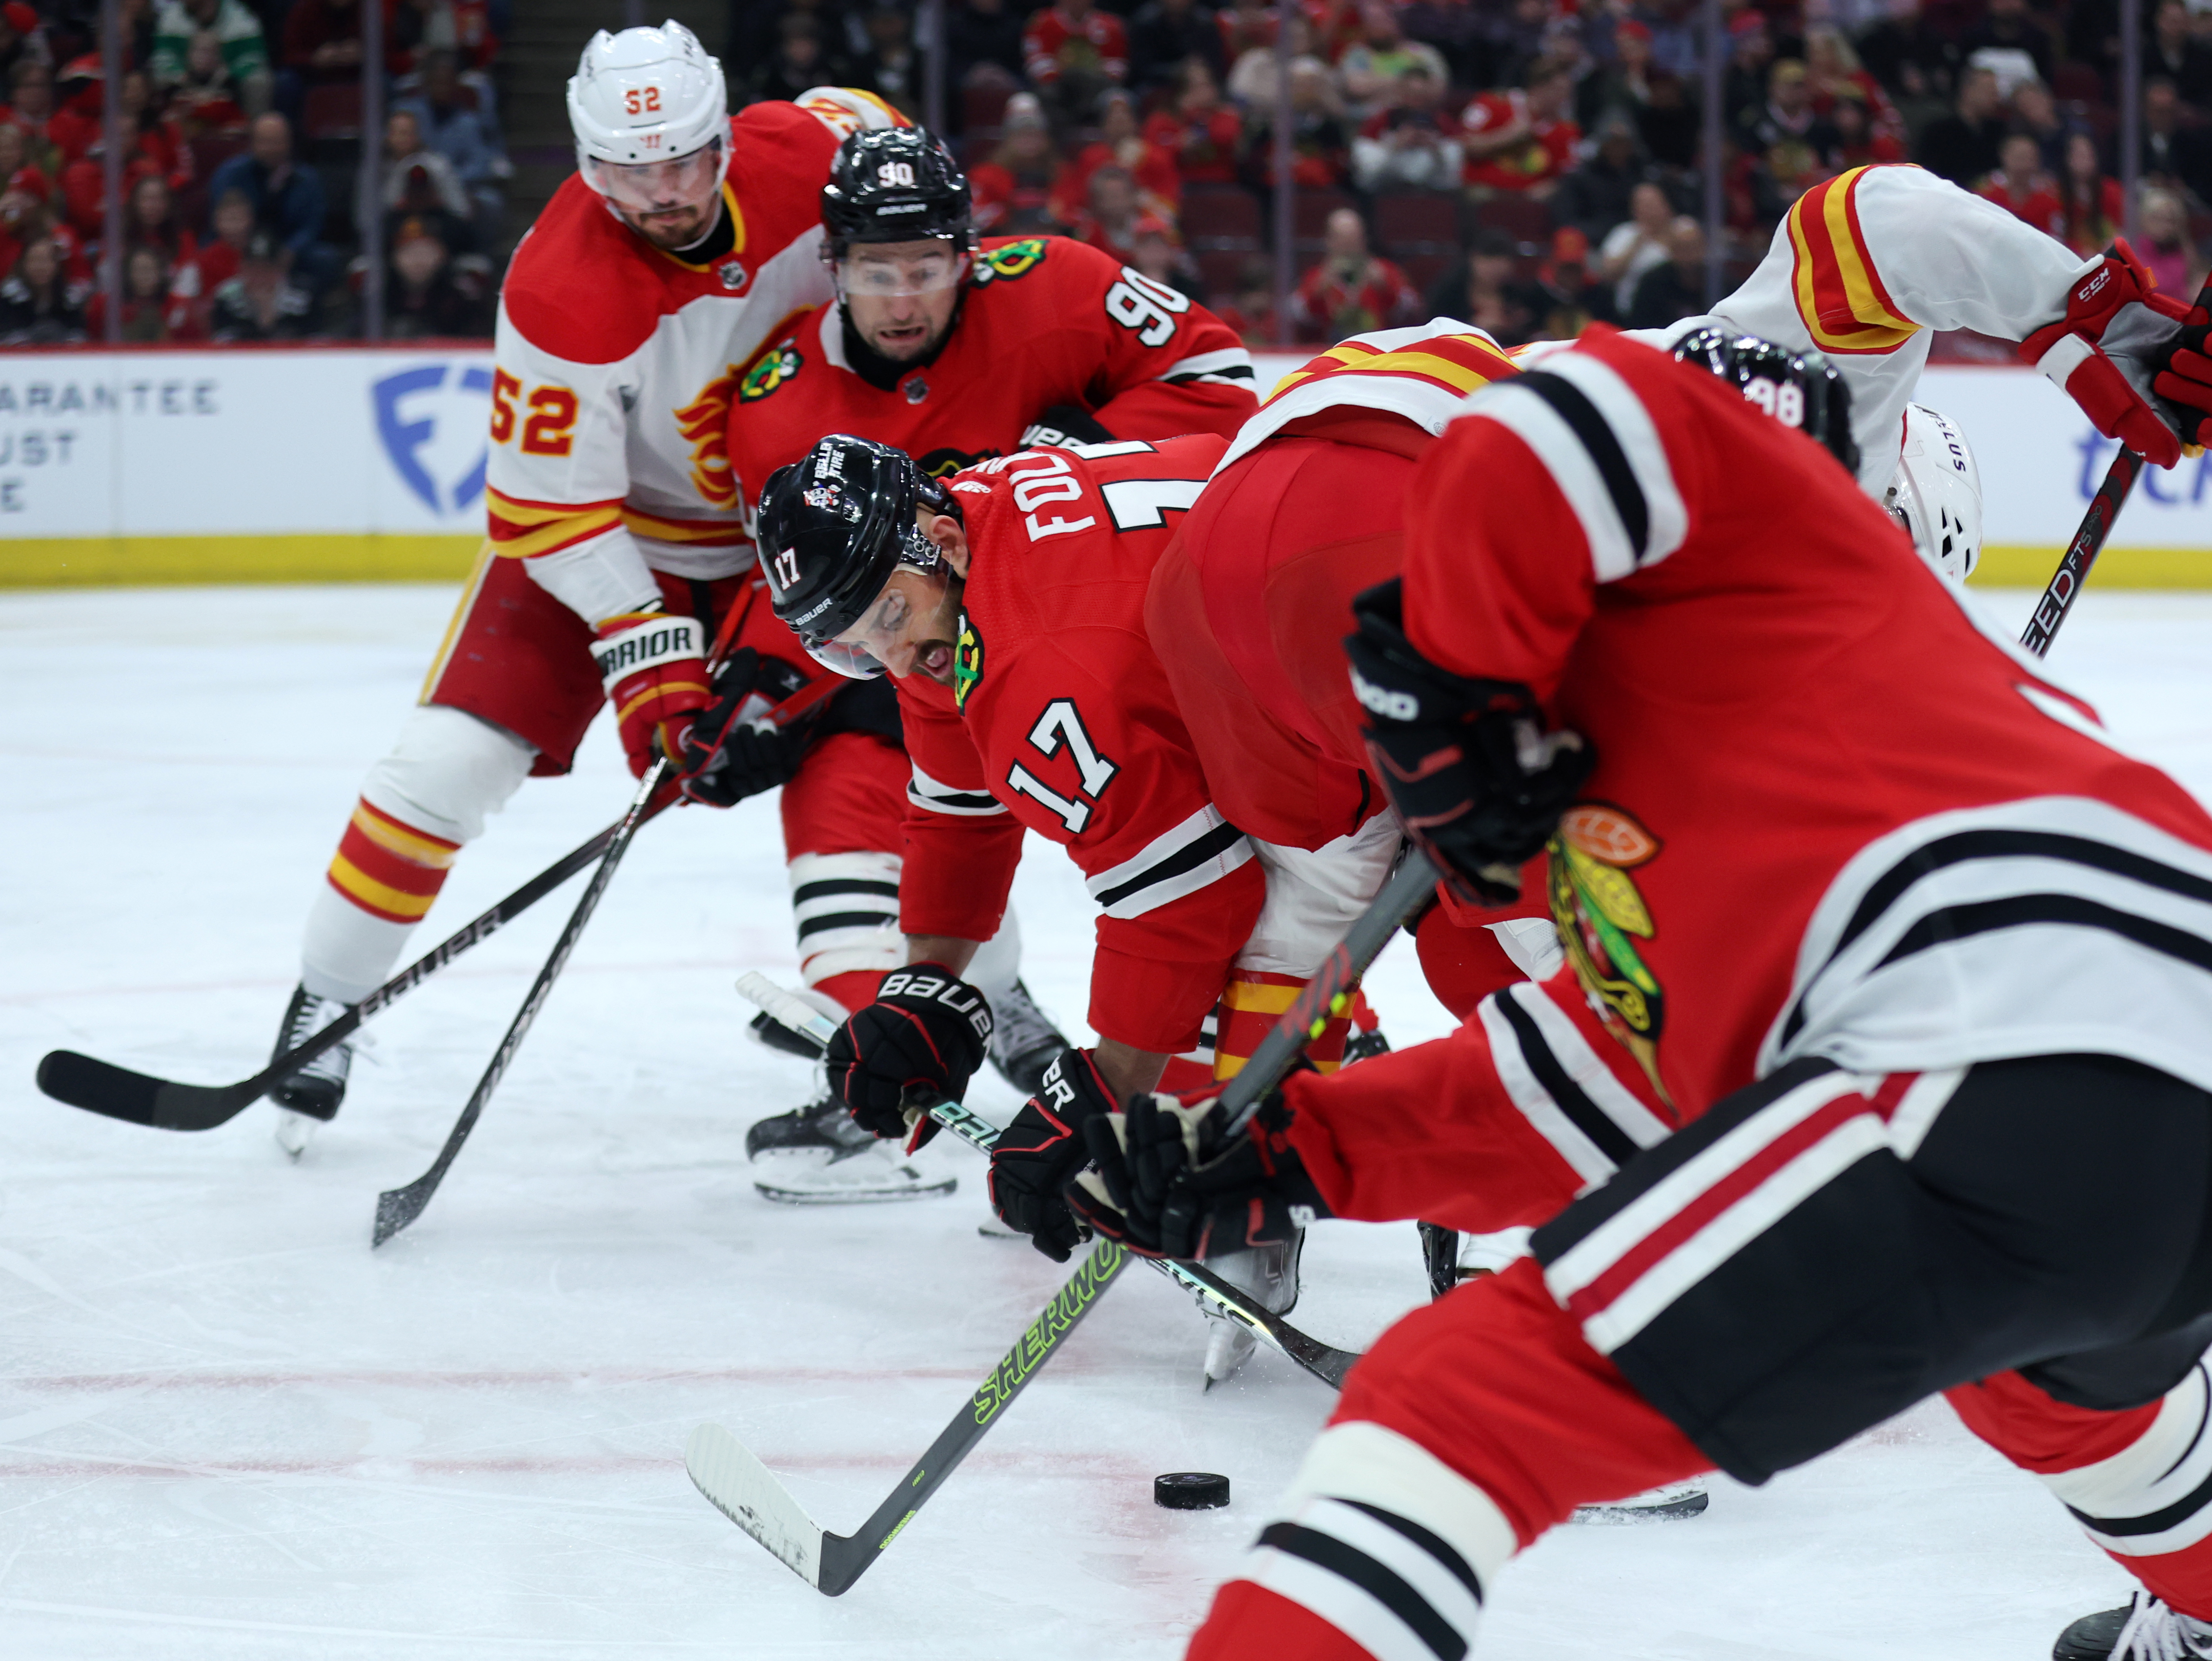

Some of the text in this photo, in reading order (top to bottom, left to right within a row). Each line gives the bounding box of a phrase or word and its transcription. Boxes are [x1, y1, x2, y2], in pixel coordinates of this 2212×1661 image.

[626, 86, 661, 115] 52
[878, 162, 914, 188] 90
[2078, 267, 2110, 300] CCM
[1105, 265, 1191, 347] 90
[490, 364, 580, 458] 52
[1744, 376, 1804, 428] 98
[813, 442, 832, 479] BELLE
[829, 449, 846, 476] TIRE
[774, 547, 801, 591] 17
[1005, 697, 1121, 834] 17
[973, 1237, 1128, 1425] SHERWO
